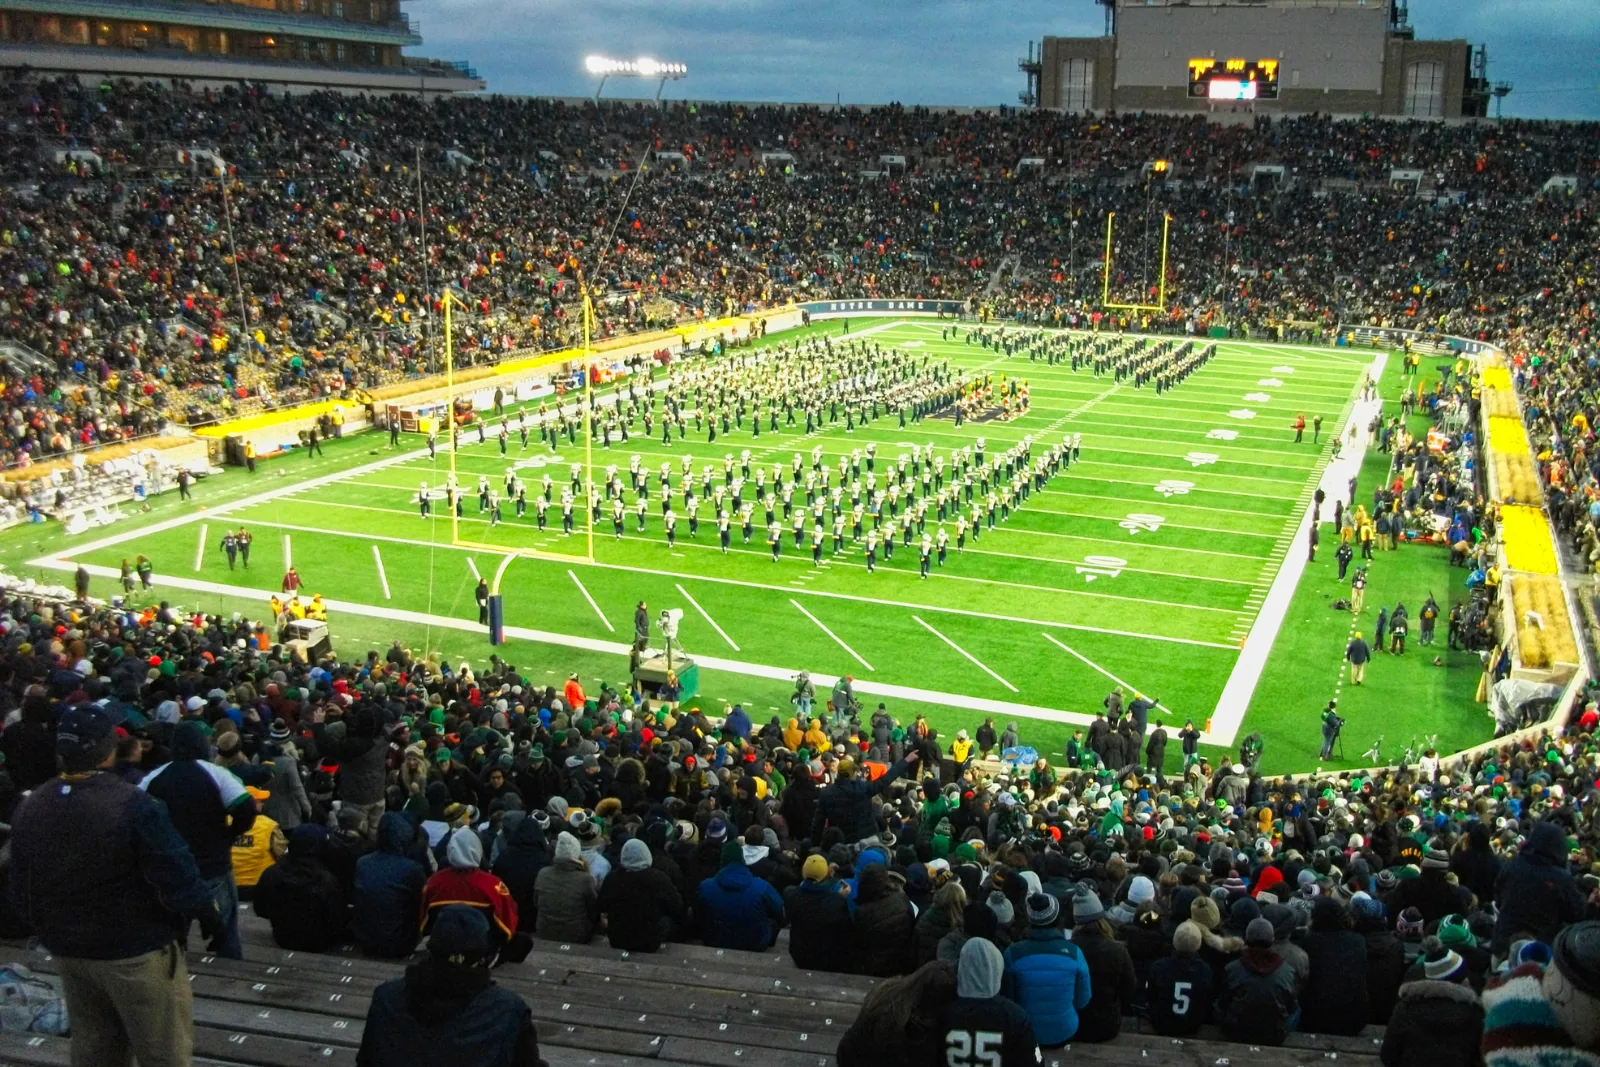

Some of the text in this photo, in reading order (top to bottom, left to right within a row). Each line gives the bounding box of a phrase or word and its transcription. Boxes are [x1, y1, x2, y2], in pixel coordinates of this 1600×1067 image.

[831, 301, 924, 311] NOTRE DAME
[1076, 556, 1127, 578] 10
[1172, 981, 1191, 1014] 5
[945, 1031, 1003, 1067] 25
